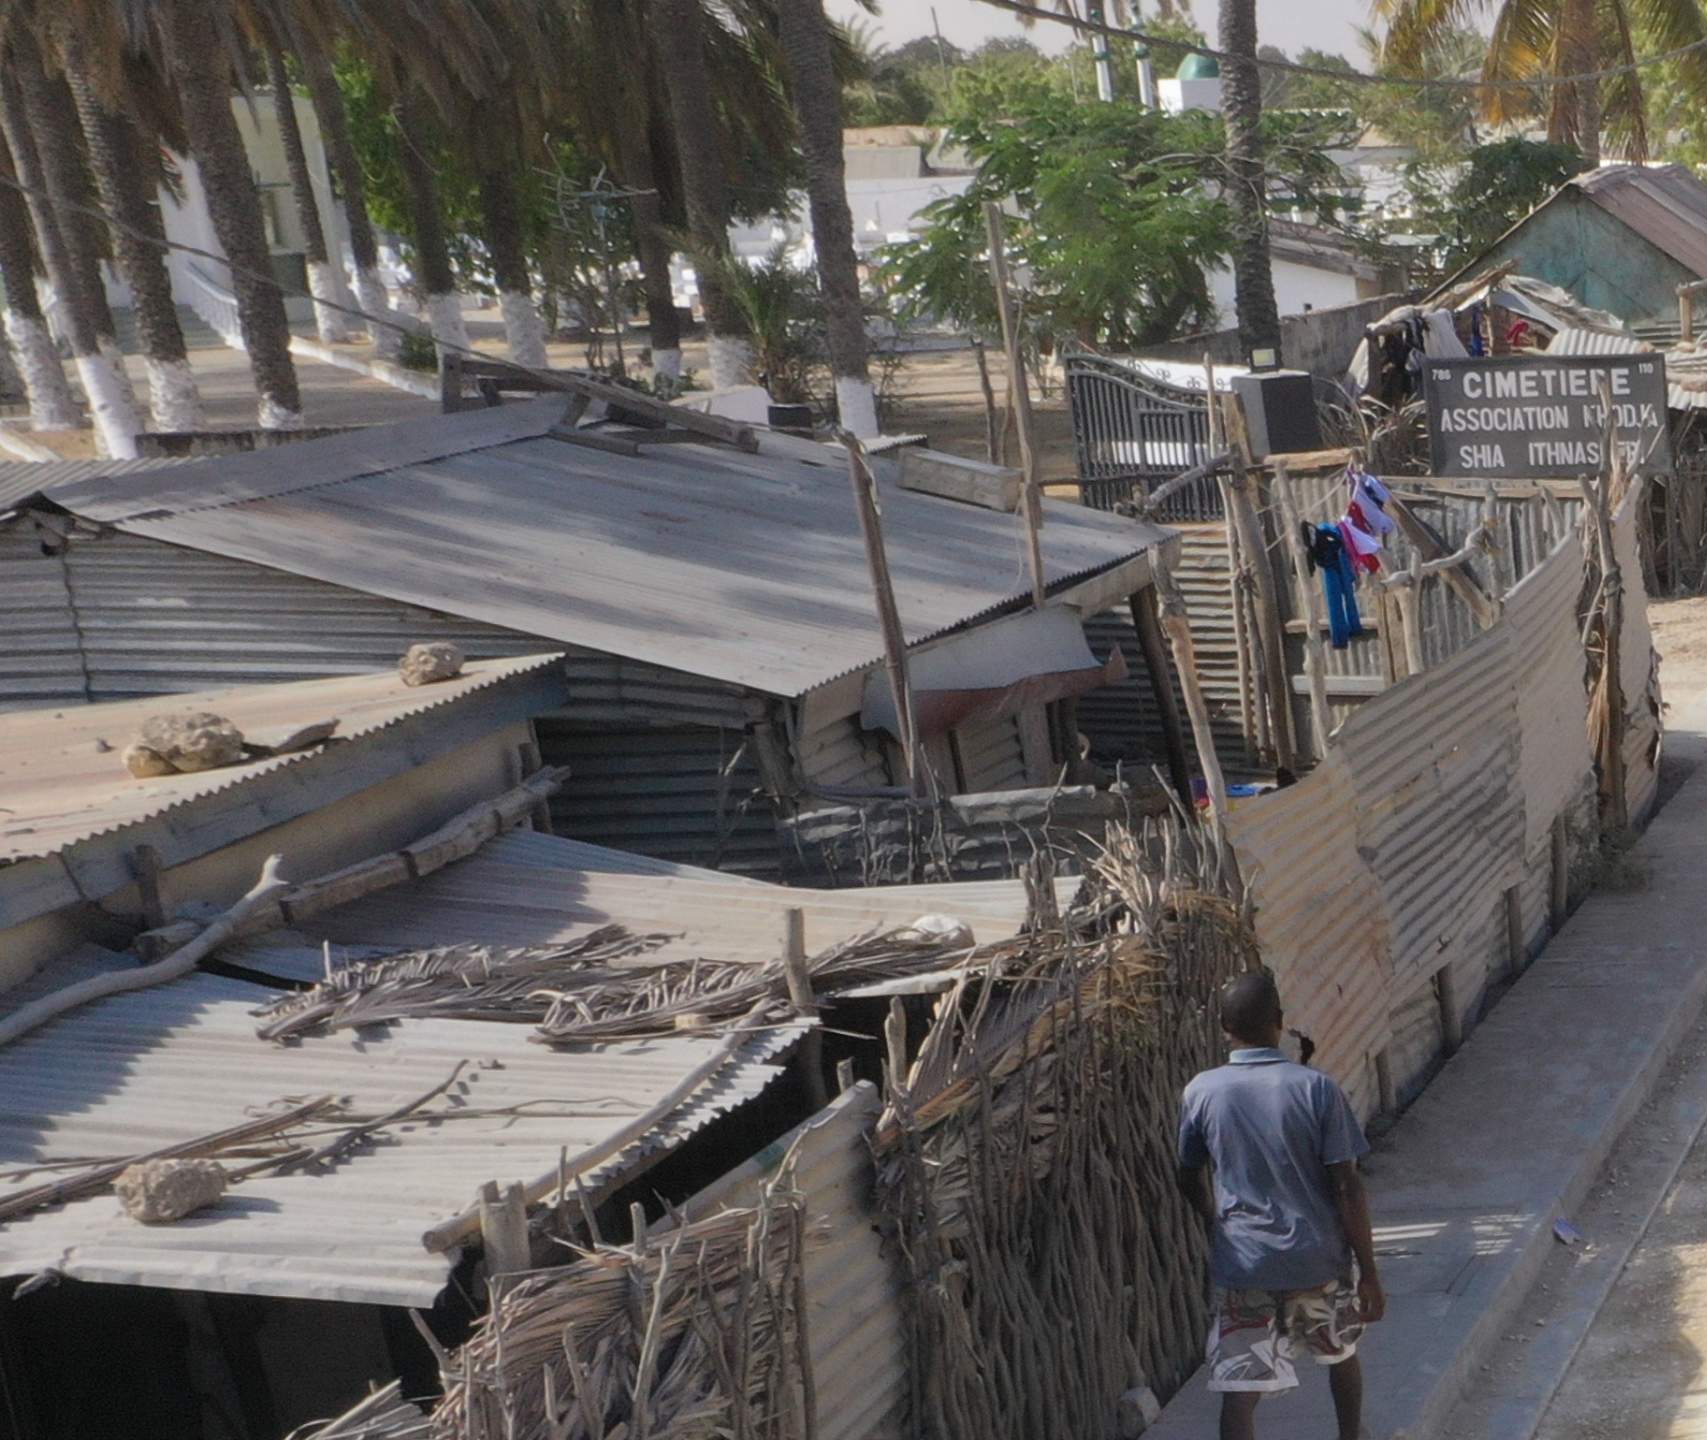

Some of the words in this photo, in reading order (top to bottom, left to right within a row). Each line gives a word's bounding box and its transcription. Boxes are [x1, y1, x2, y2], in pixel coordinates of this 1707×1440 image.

[1463, 368, 1631, 398] CIMETIERE
[1440, 405, 1569, 432] ASSOCIATION
[1459, 444, 1506, 469] SHIA
